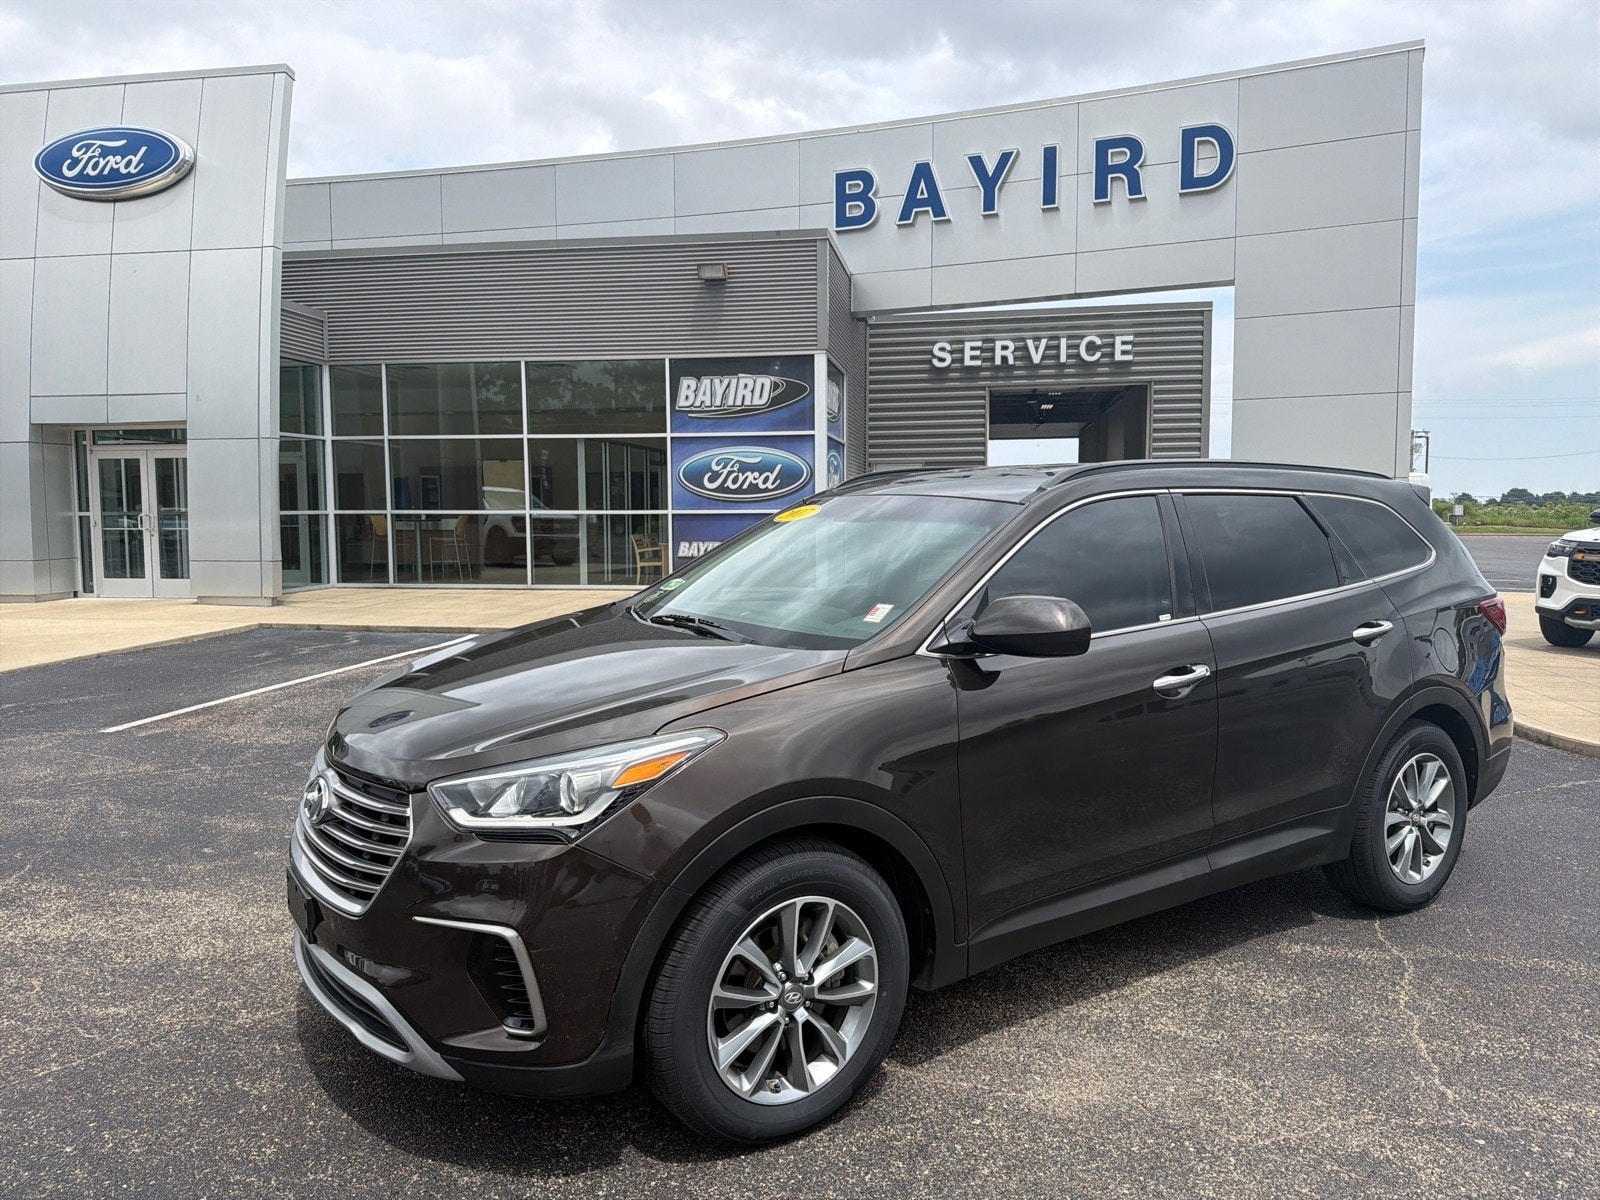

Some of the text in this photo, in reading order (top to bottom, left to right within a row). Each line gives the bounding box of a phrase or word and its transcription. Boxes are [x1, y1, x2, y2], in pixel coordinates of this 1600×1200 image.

[62, 139, 148, 178] Ford
[833, 122, 1236, 232] BAYIRD
[931, 334, 1135, 369] SERVICE
[675, 374, 774, 410] BAYIRD
[702, 455, 783, 489] Ford
[677, 540, 722, 558] BAYI
[749, 881, 778, 901] TRAIL
